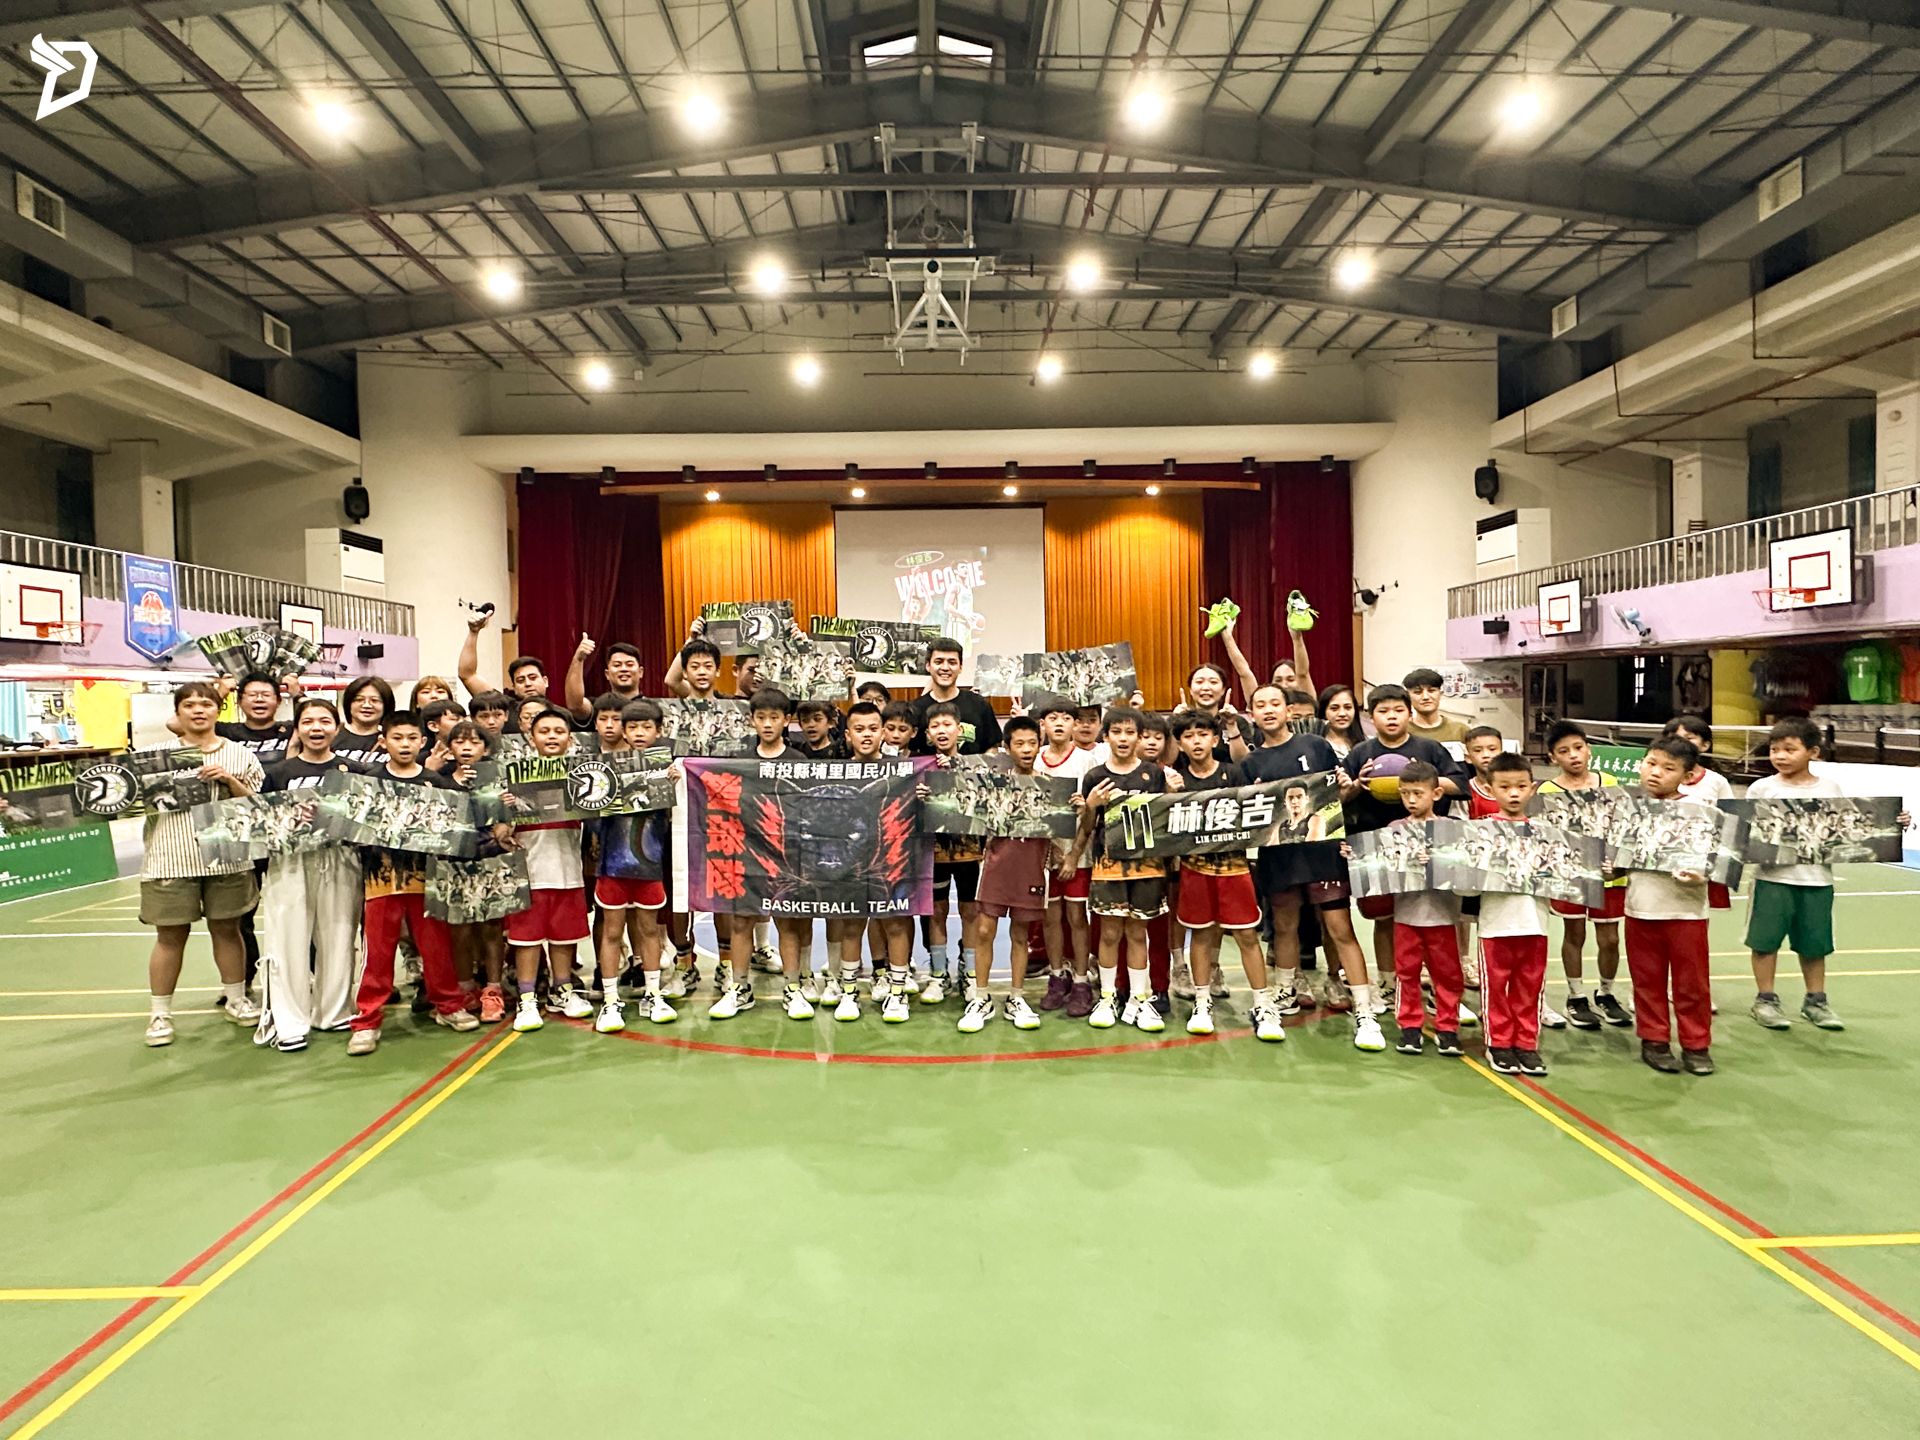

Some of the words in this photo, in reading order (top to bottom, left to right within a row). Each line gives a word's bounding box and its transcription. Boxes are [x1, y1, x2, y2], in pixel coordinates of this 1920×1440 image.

[759, 761, 914, 780] 南投縣埔里國民小學
[1297, 756, 1310, 772] 1
[1167, 793, 1276, 834] 林俊吉
[1120, 802, 1155, 850] 11
[20, 838, 37, 848] and
[40, 835, 65, 845] never
[69, 831, 87, 841] give
[762, 898, 860, 914] BASKETBALL
[868, 898, 909, 912] TEAM
